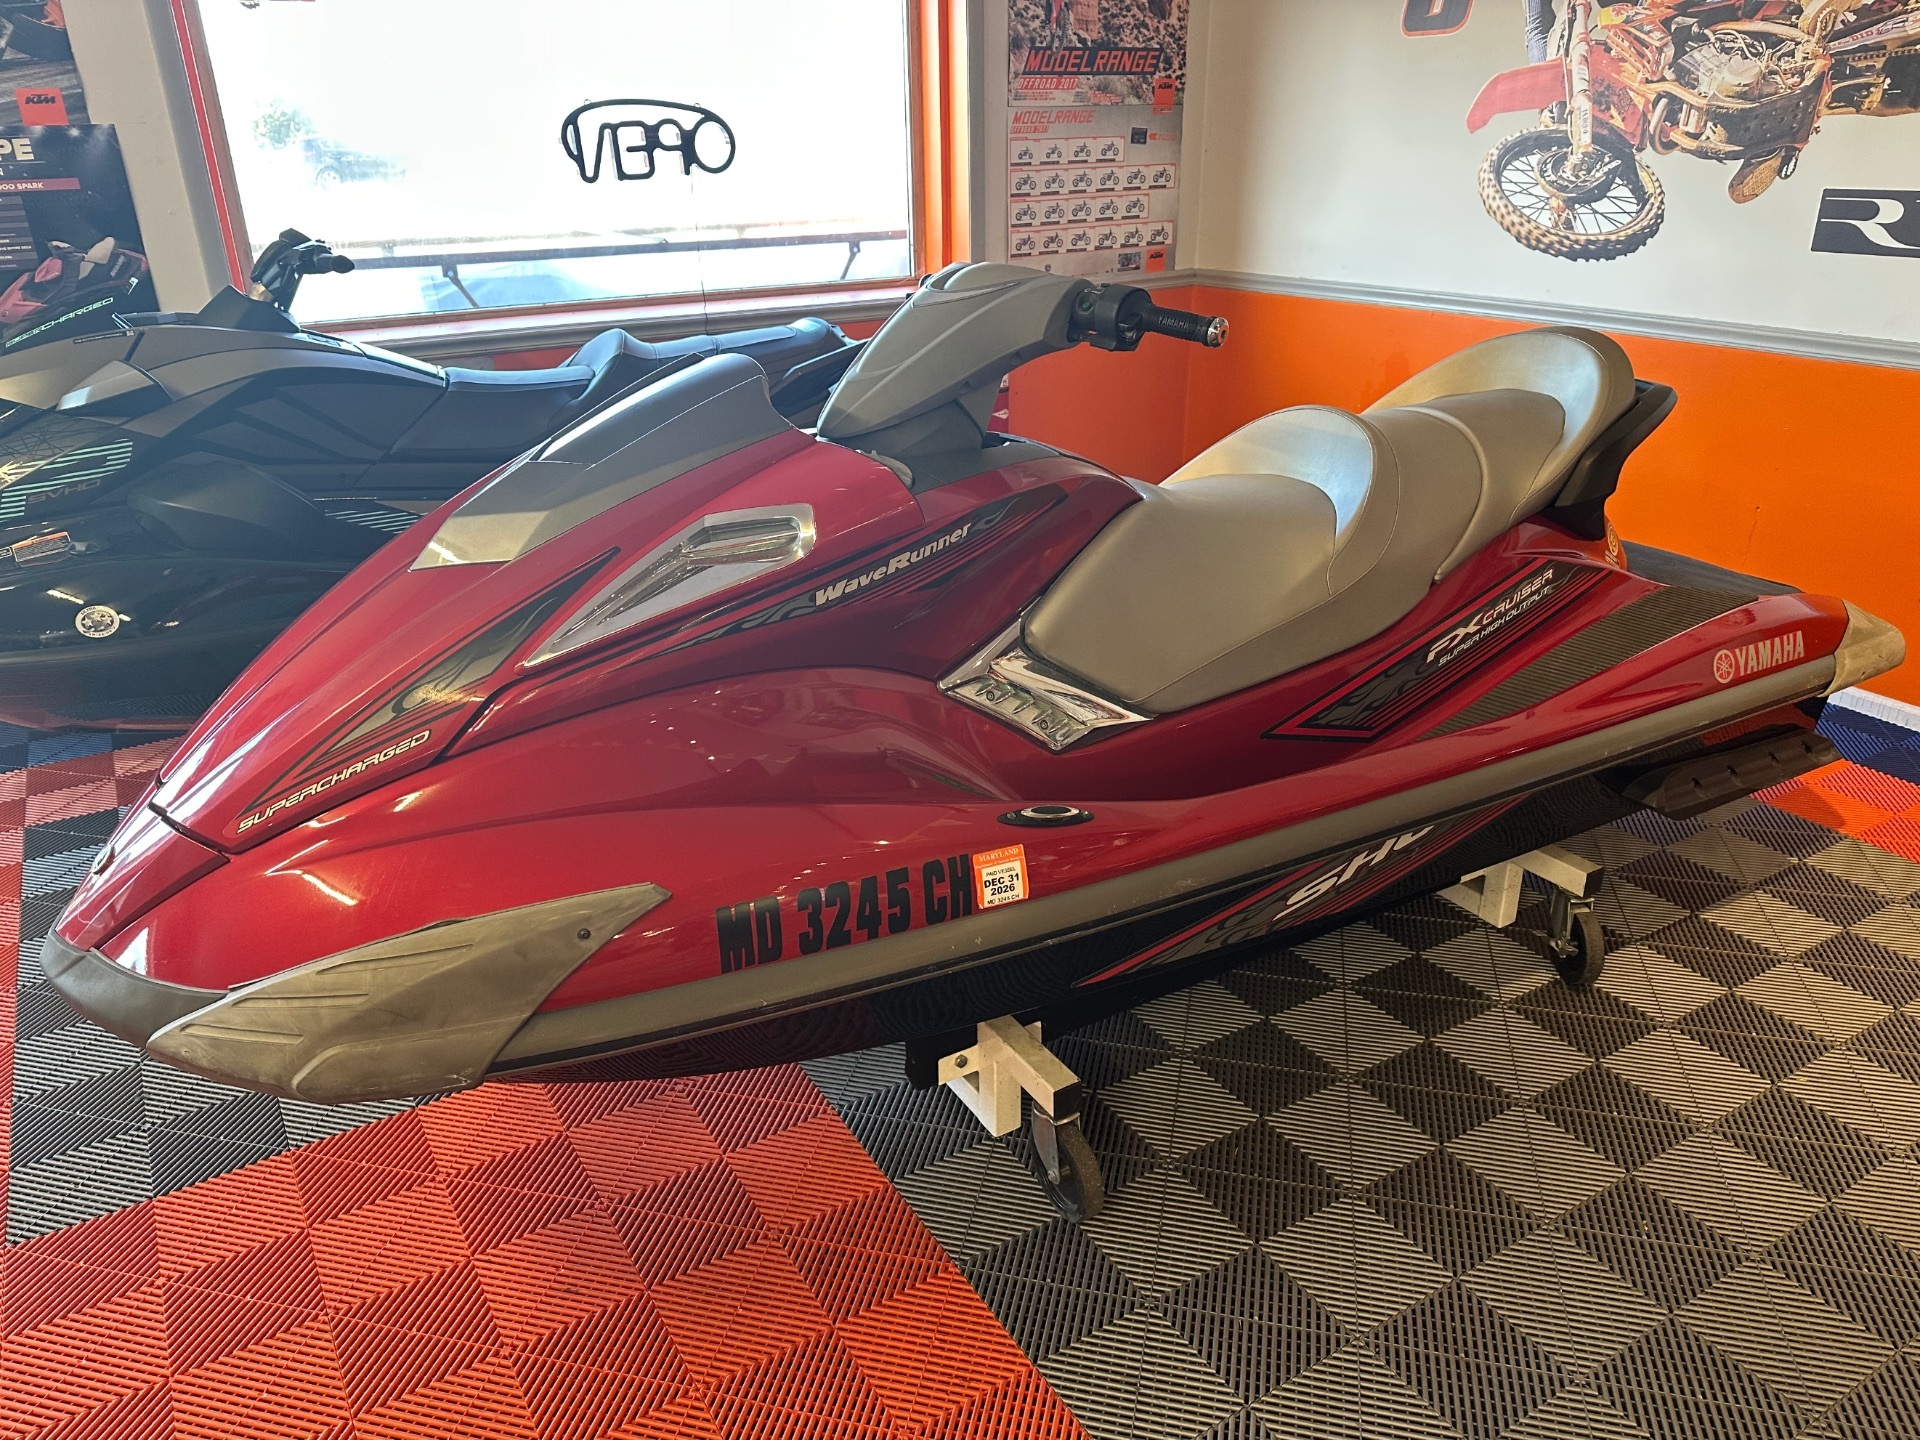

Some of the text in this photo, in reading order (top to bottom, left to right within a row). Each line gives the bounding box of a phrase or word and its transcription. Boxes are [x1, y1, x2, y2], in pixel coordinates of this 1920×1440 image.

[1025, 50, 1160, 72] MODELRANGE
[1018, 78, 1079, 89] OFFROAD 2017
[25, 93, 56, 105] KTM
[1012, 109, 1096, 125] MODELRANGE
[17, 182, 44, 190] SPARK
[1149, 251, 1164, 260] KTM
[6, 297, 113, 347] RCHARGED
[1158, 314, 1189, 330] YAMAHA
[815, 523, 972, 606] WaveRunner
[1426, 568, 1554, 663] FX CRUISER
[1438, 585, 1550, 666] SUPER HIGH OUTPUT
[1734, 630, 1805, 677] YAMAHA
[236, 729, 432, 834] SUPERCHARGED
[978, 847, 1019, 863] MARYLAND
[984, 872, 1020, 889] DEC 31
[990, 883, 1016, 897] 2026
[715, 853, 973, 974] MD 3245 CH
